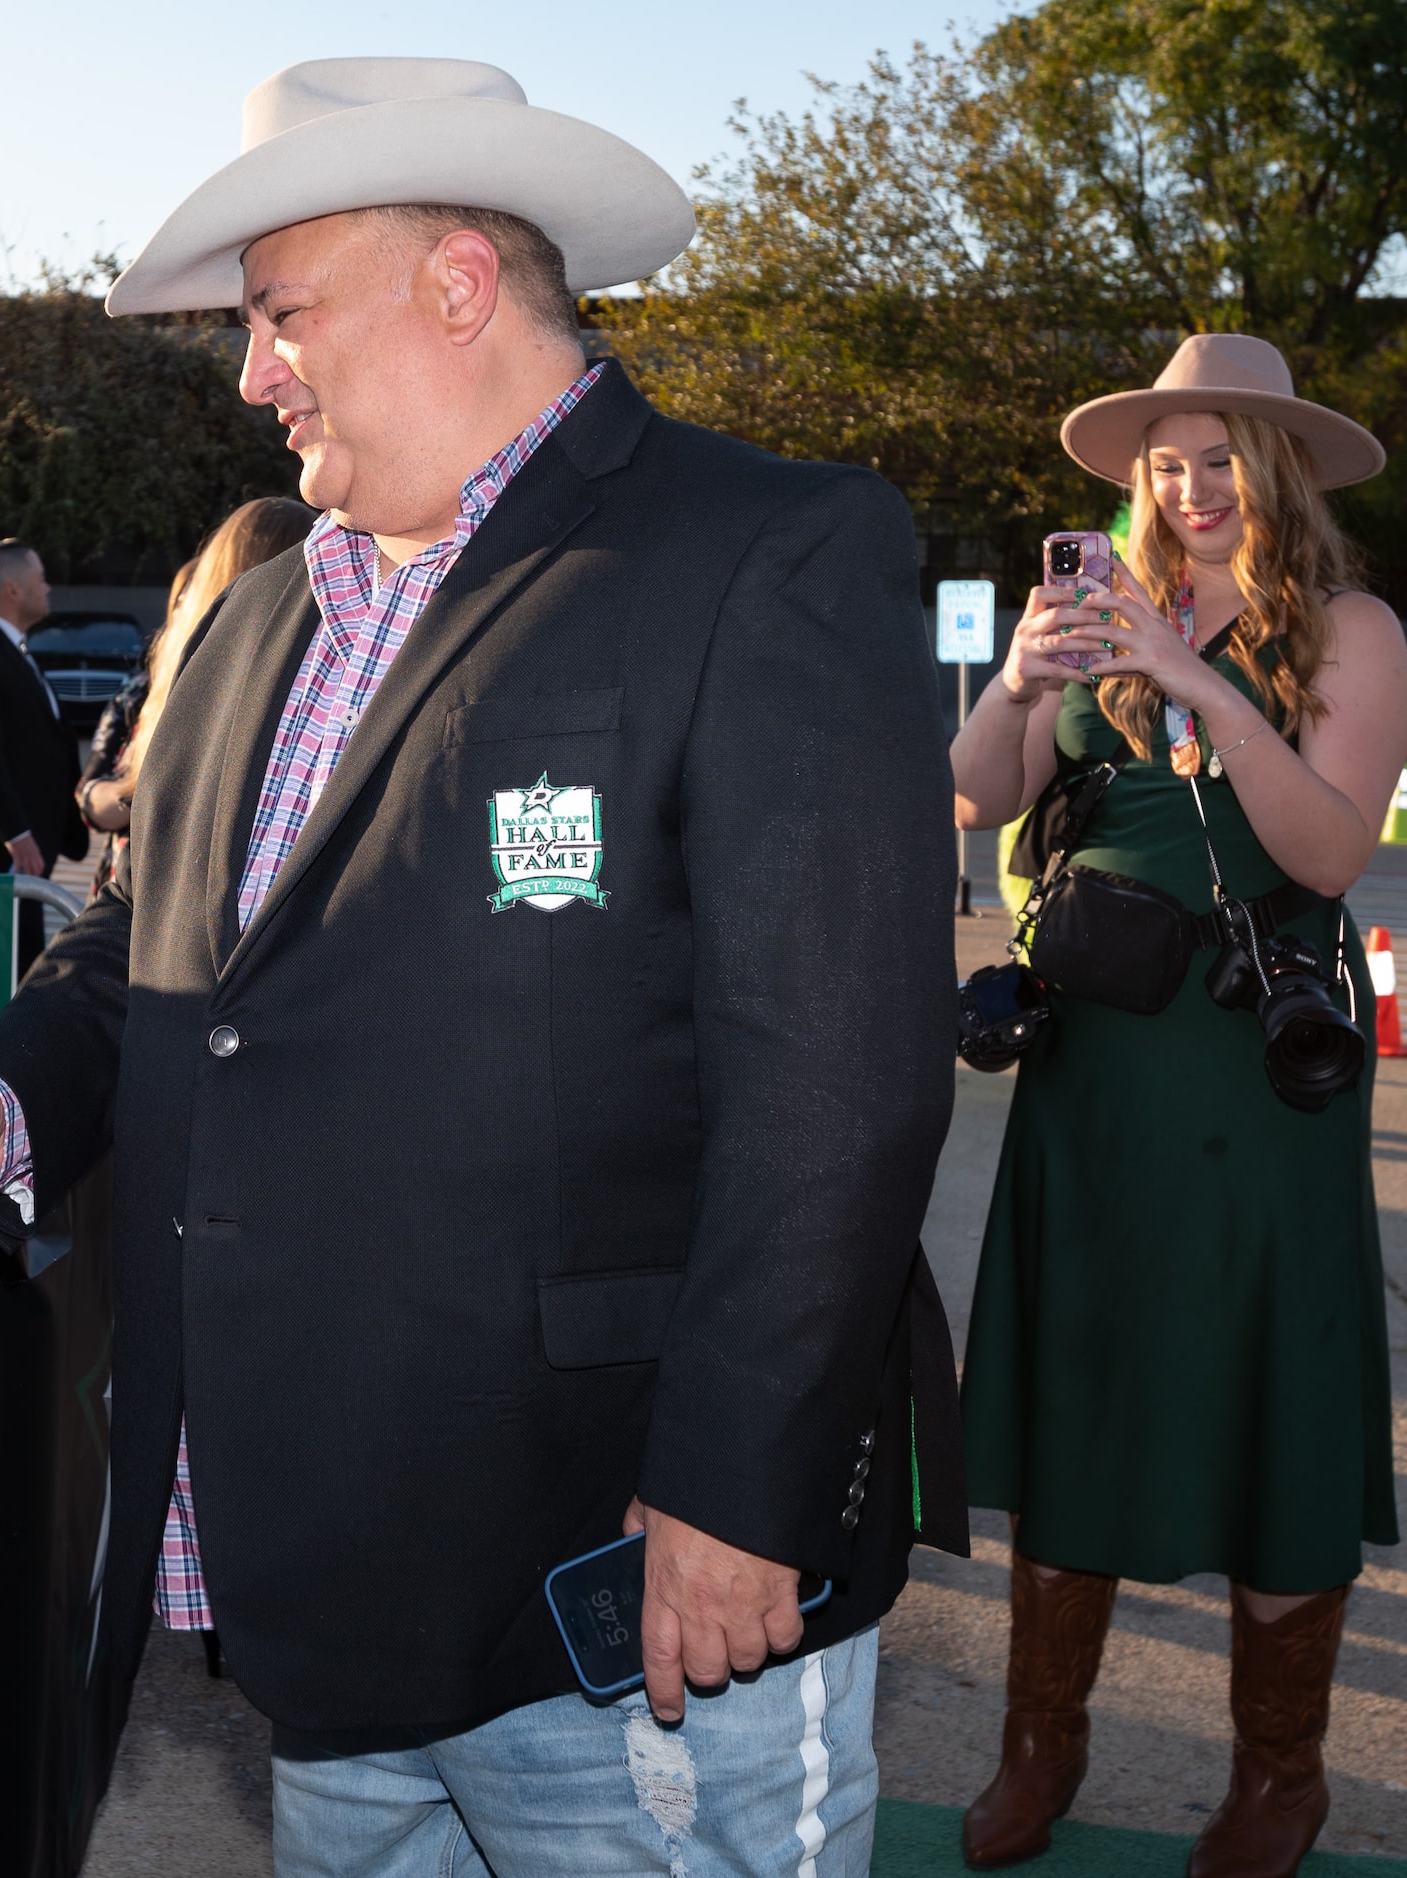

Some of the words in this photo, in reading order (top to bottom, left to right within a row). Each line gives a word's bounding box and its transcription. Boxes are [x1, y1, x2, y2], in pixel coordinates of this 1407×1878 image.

[501, 816, 548, 827] DALLAS
[551, 815, 590, 825] STARS
[506, 825, 586, 844] HALL
[536, 839, 557, 857] of
[507, 852, 588, 871] FAME
[555, 880, 588, 895] 2022
[1296, 953, 1318, 967] SONY
[591, 1589, 629, 1647] 5:46
